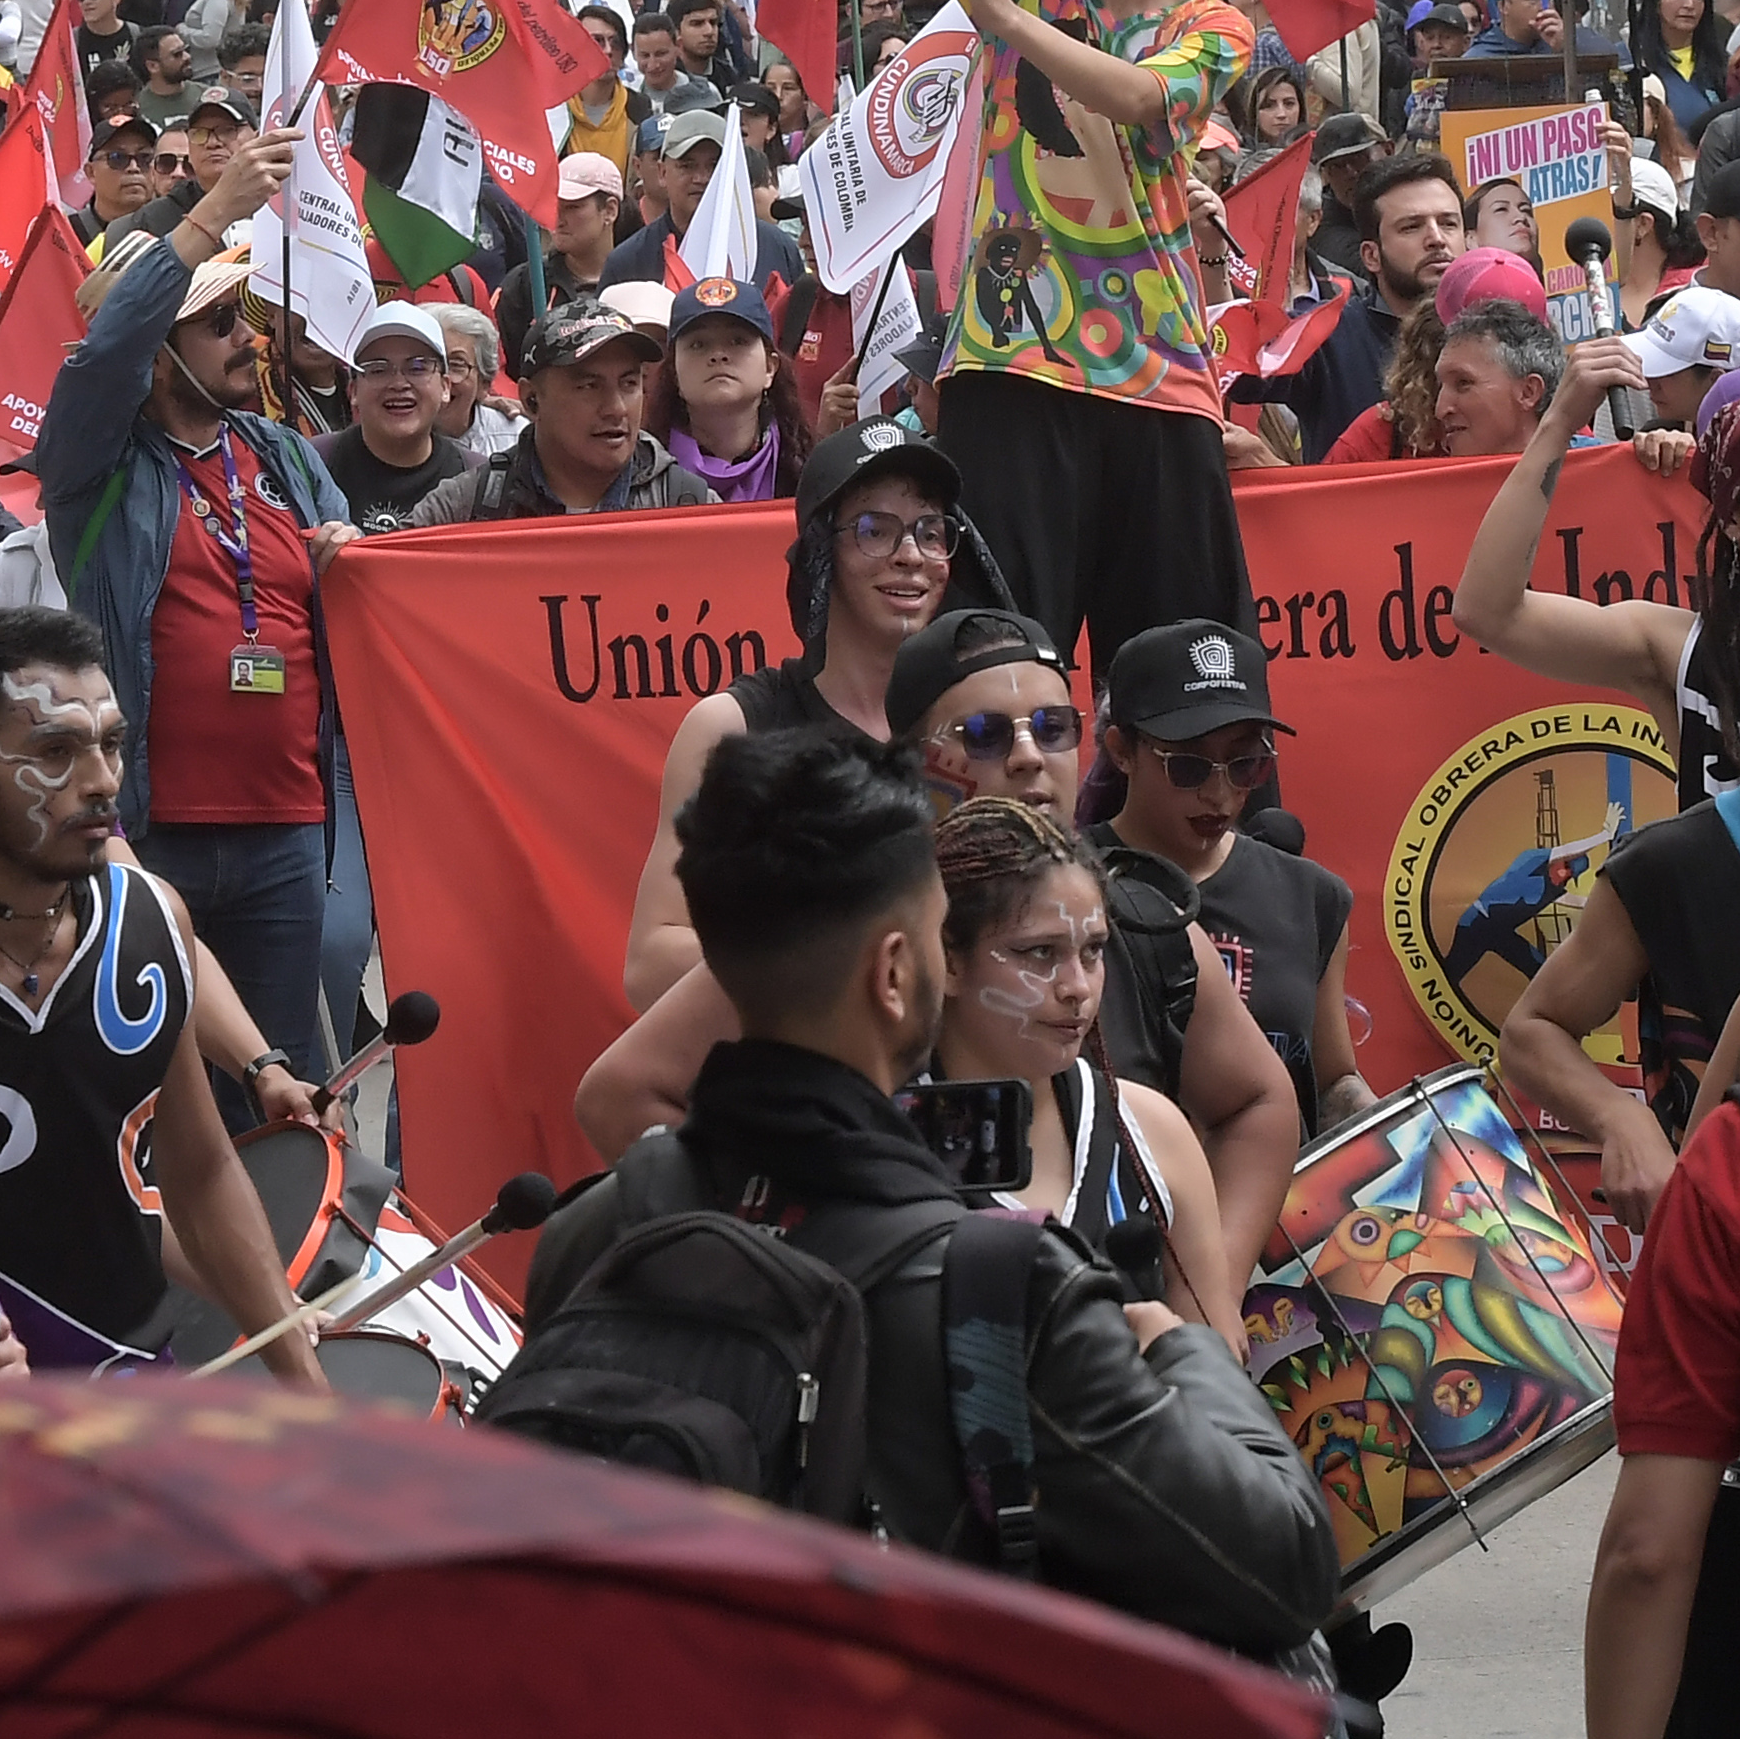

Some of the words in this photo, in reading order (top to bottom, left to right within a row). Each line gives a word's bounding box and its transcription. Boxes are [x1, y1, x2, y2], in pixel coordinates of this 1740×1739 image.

[420, 45, 451, 76] USO
[872, 57, 916, 176] CUNDINAMARCA
[1468, 139, 1500, 187] ¡NI
[1505, 119, 1538, 172] UN
[1542, 107, 1603, 162] PASO
[829, 151, 842, 170] DE
[842, 134, 863, 190] UNITARIA
[855, 189, 867, 206] DE
[1529, 152, 1603, 204] ATRÁS!
[299, 189, 342, 217] CENTRAL
[833, 170, 855, 235] COLOMBIA
[1, 392, 47, 422] APOY
[539, 594, 765, 704] Unión
[1378, 540, 1461, 662] de
[1393, 834, 1429, 972] SINDICAL
[1418, 729, 1526, 828] OBRERA
[1530, 714, 1573, 741] DE
[1582, 713, 1622, 735] LA
